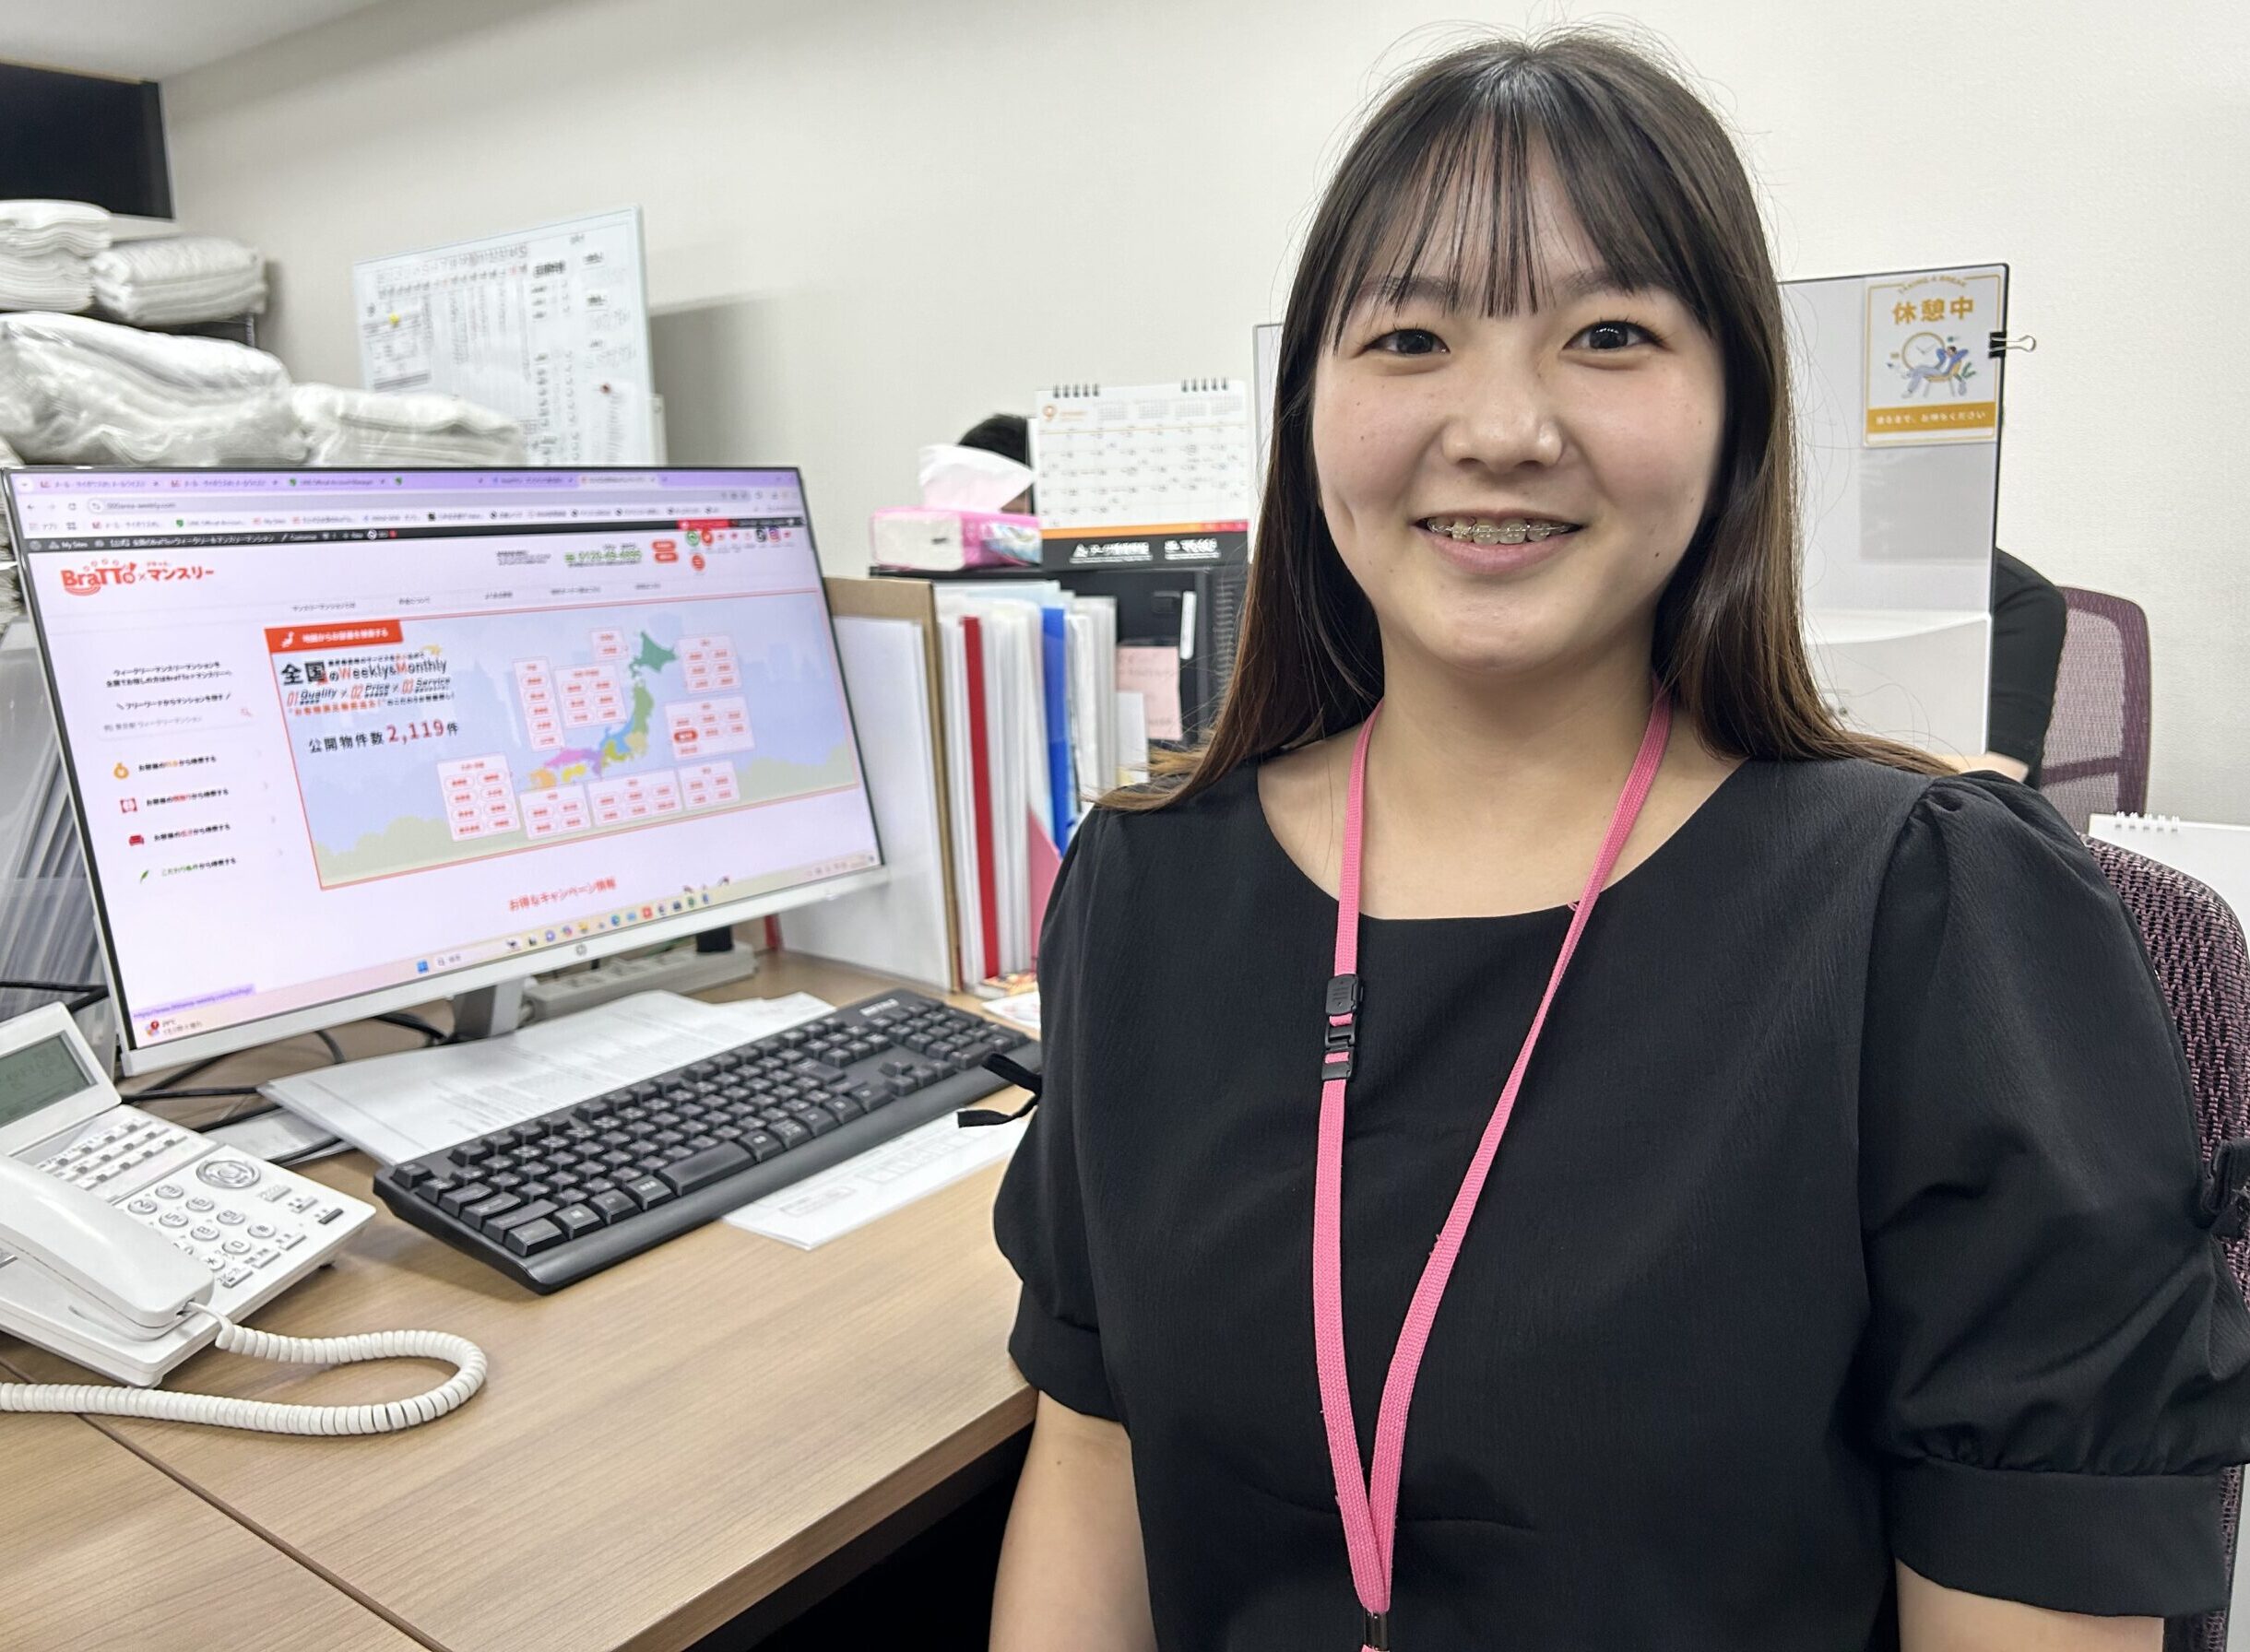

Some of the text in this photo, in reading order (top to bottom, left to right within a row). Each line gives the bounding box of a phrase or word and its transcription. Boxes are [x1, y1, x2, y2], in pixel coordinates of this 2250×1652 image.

[1892, 295, 1973, 324] 休憩中
[148, 566, 214, 581] マンスリー
[365, 683, 390, 693] Price
[416, 677, 450, 688] Service
[308, 718, 458, 753] 公開物件数2,119件
